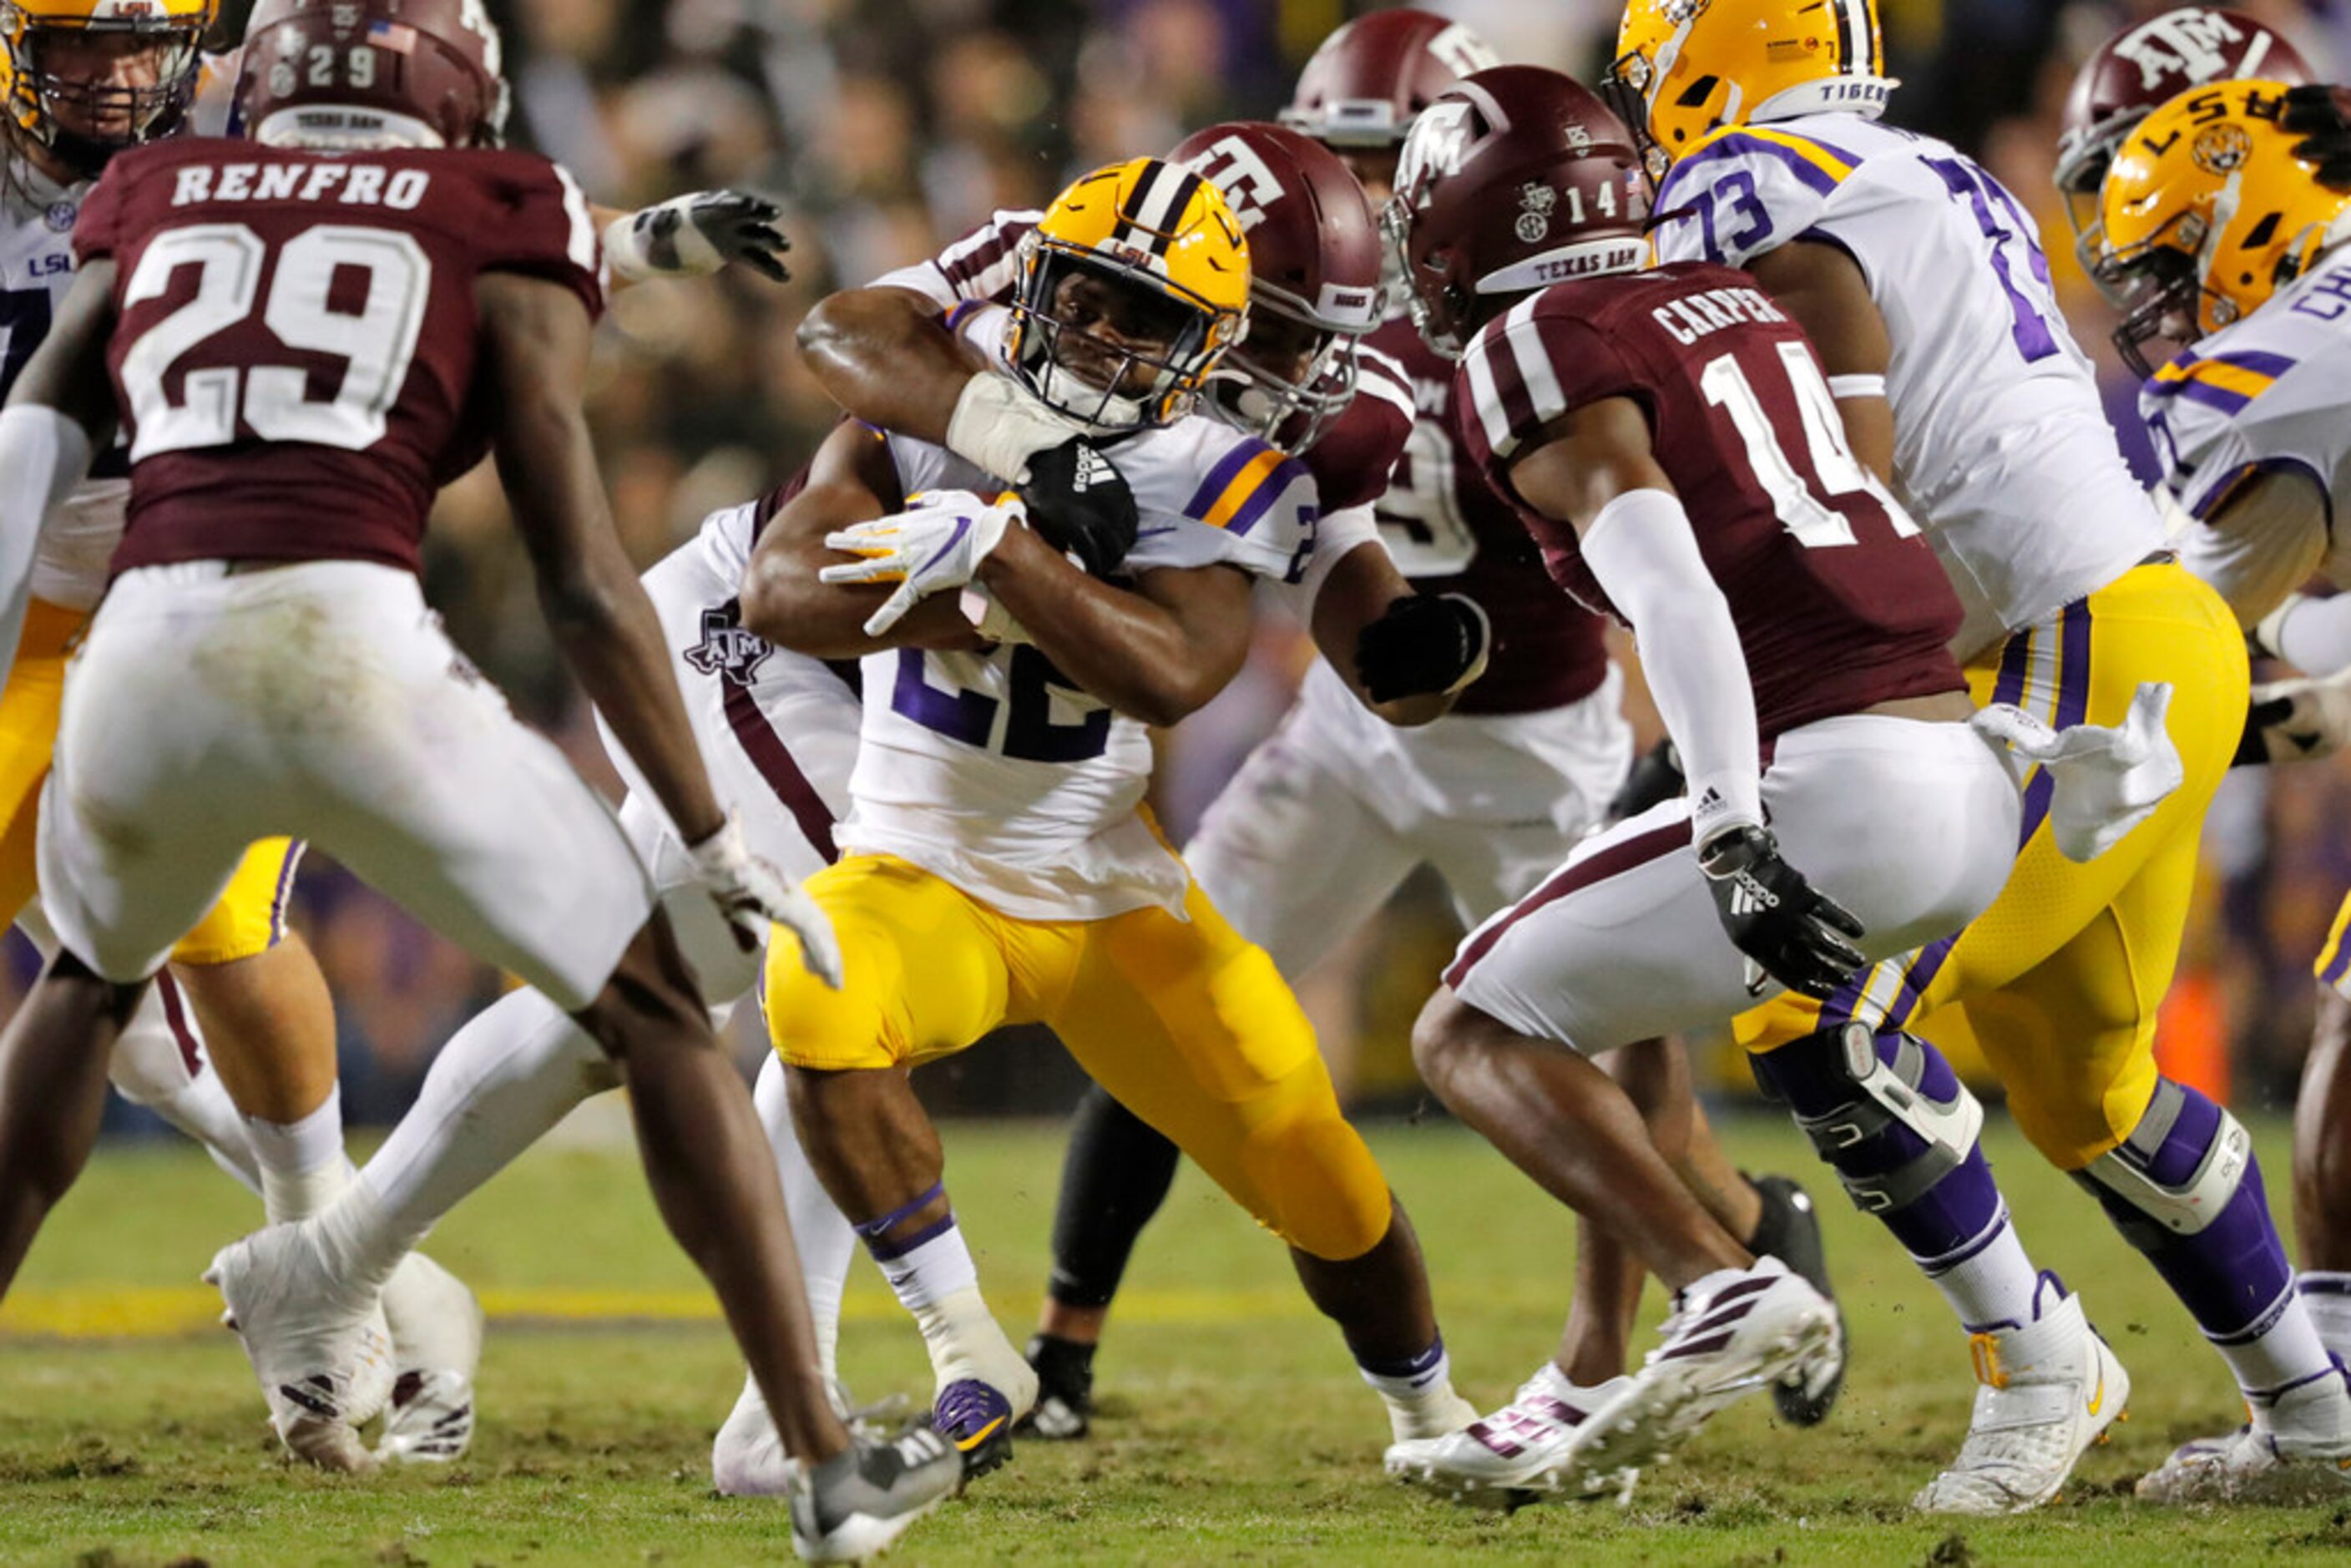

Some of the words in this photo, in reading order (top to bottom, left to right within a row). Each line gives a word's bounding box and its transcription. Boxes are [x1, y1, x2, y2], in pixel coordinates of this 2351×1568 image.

[307, 45, 375, 89] 29
[171, 164, 430, 210] RENFRO
[1565, 180, 1617, 225] 14
[1678, 169, 1773, 266] 73
[1534, 254, 1600, 281] TEXAS
[1651, 287, 1788, 346] CARPE
[124, 223, 432, 465] 29
[1700, 341, 1922, 549] 14
